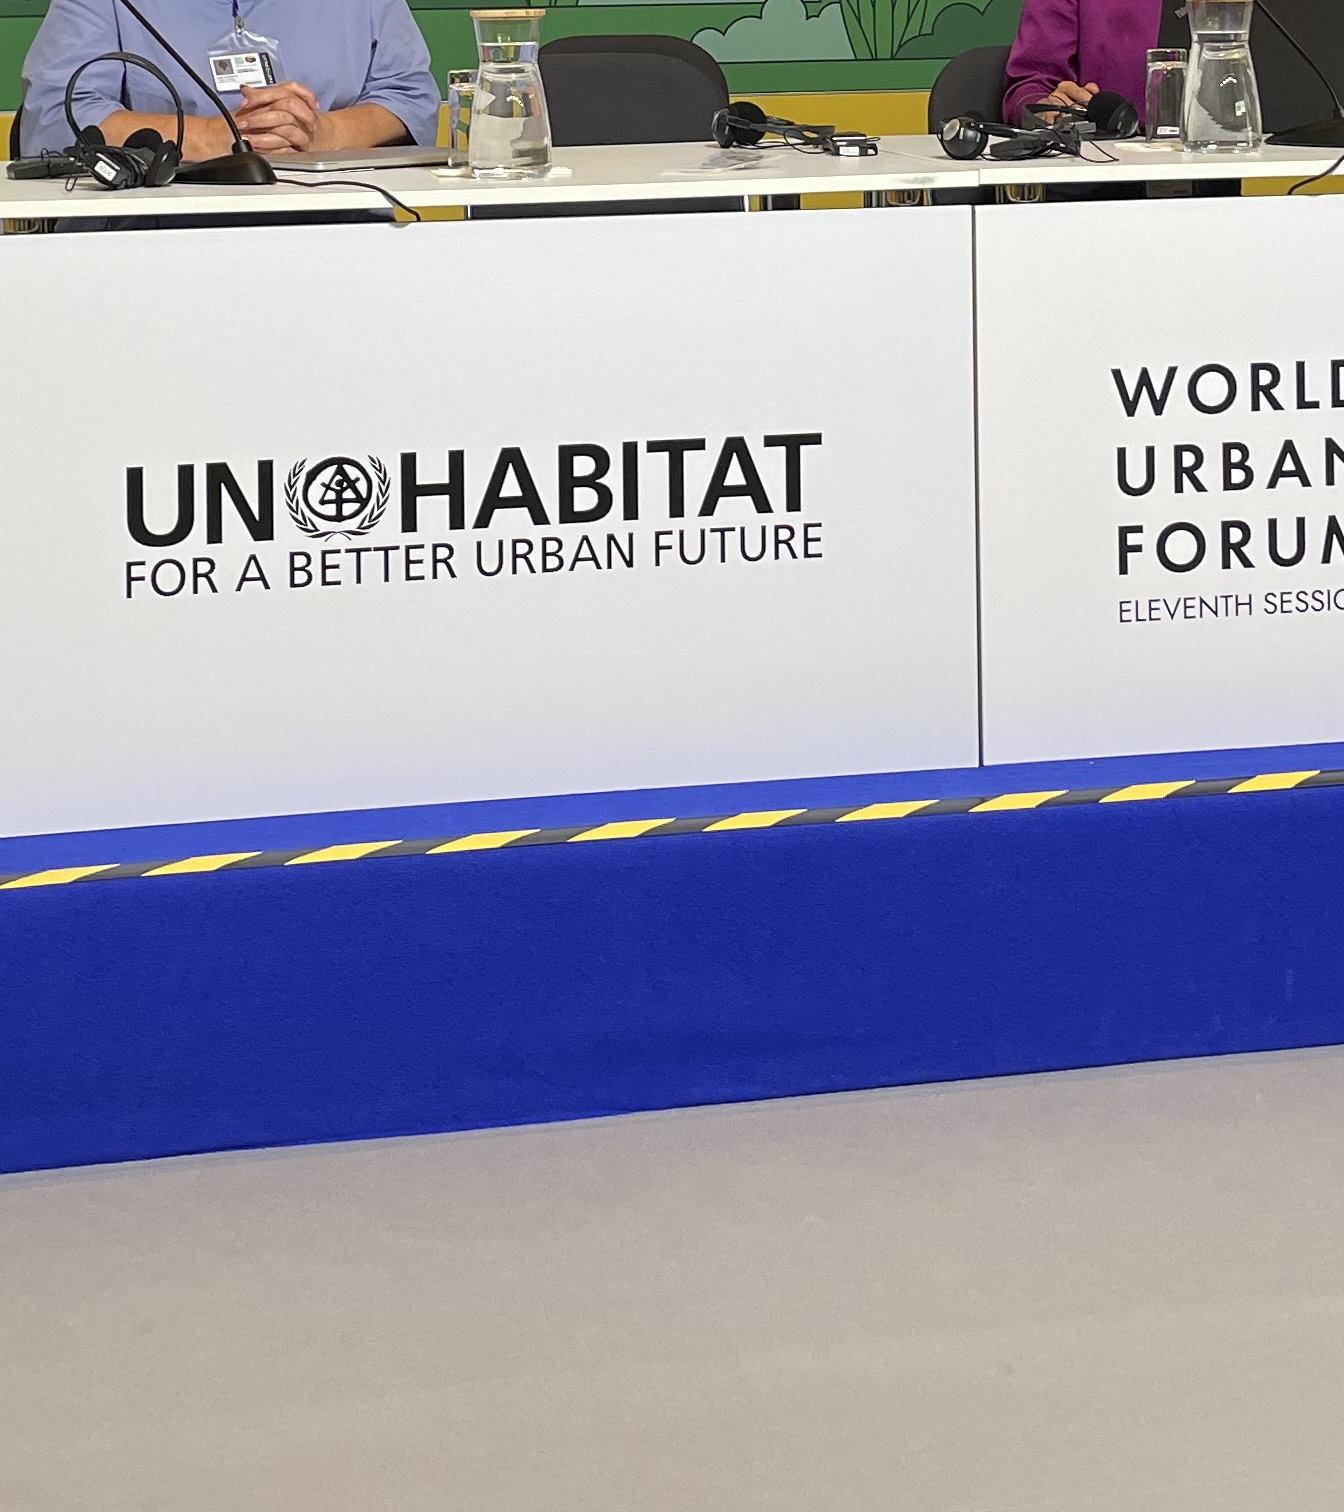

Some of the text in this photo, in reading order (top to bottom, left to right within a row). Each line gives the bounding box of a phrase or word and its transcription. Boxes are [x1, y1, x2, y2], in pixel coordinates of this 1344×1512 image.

[126, 432, 823, 548] UN HABITAT
[125, 522, 823, 599] FOR A BETTER URBAN FUTURE
[1119, 593, 1253, 624] ELEVENTH
